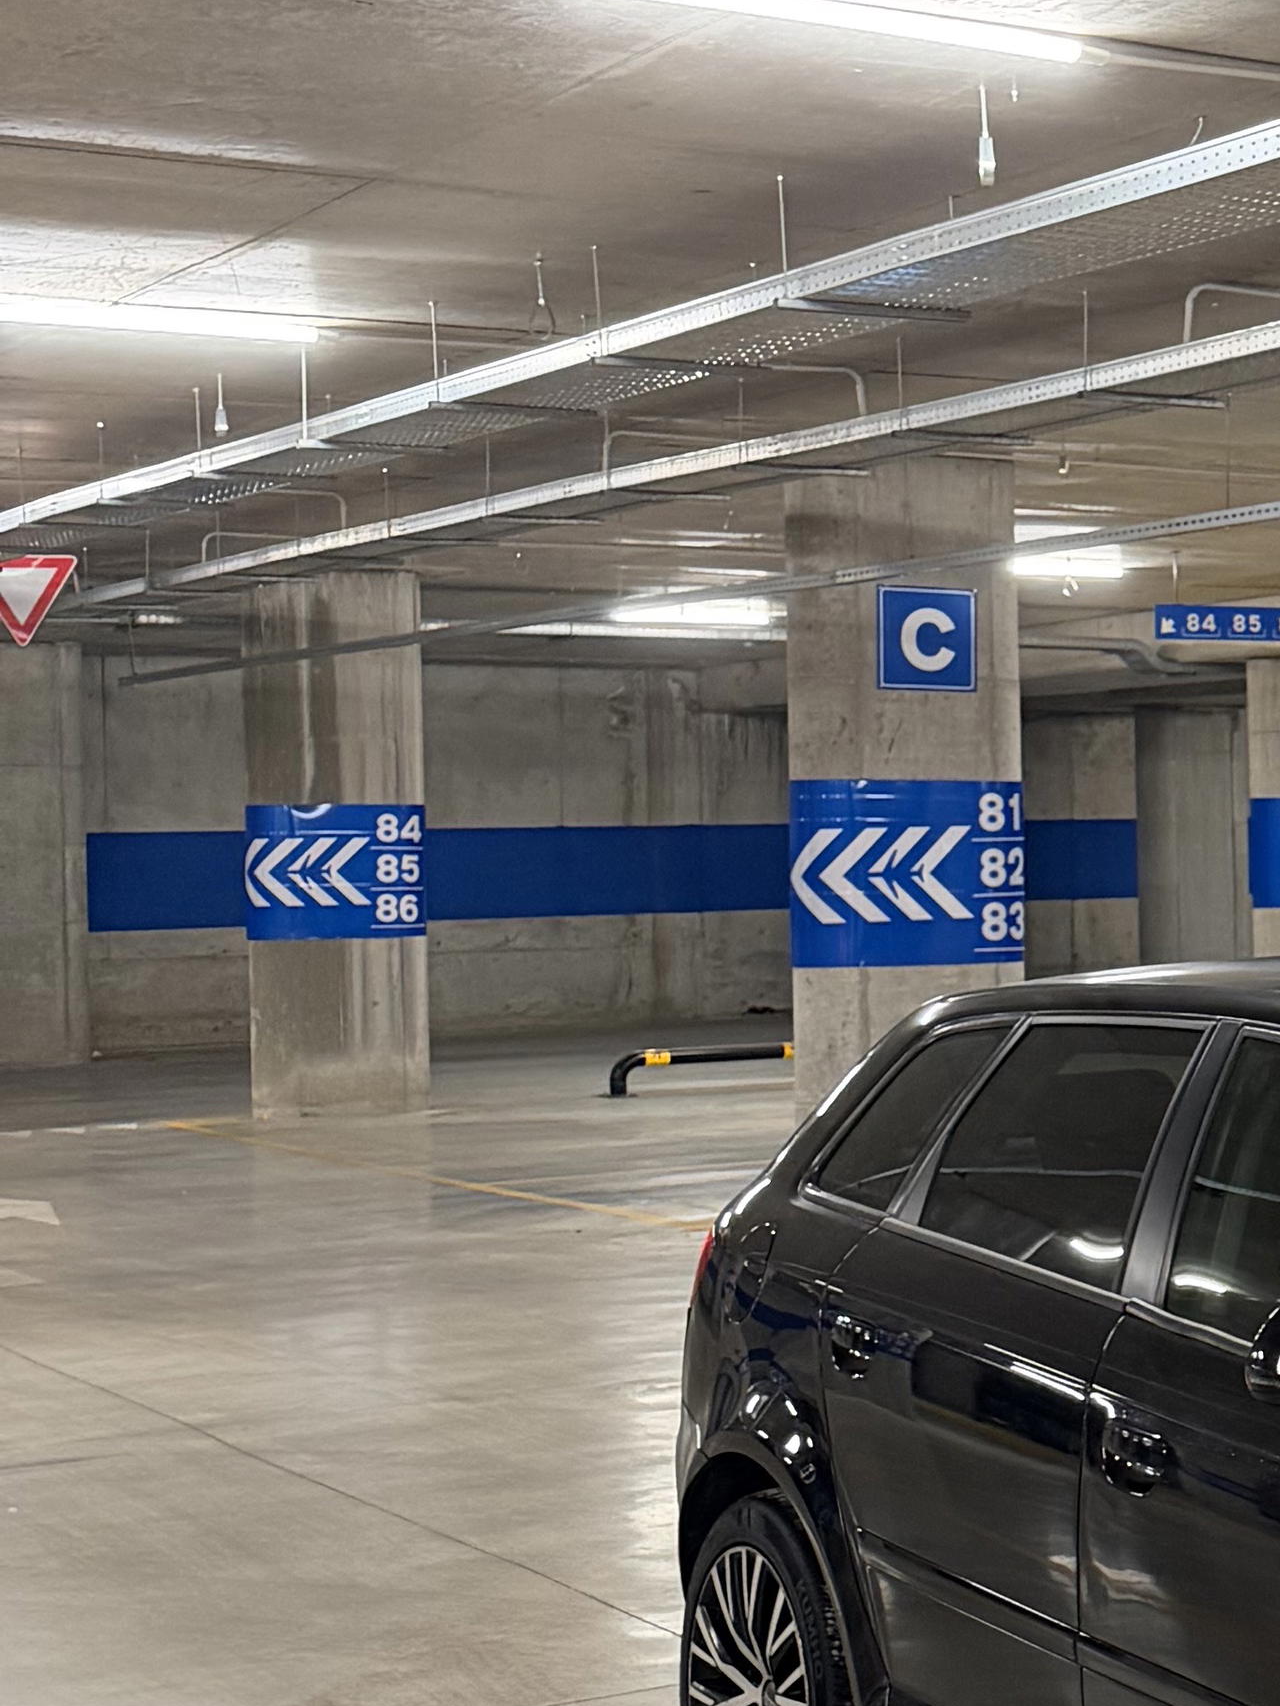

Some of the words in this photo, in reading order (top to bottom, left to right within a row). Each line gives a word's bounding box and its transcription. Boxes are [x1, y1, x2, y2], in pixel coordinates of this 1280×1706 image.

[901, 607, 956, 672] C
[1186, 612, 1217, 632] 84
[1232, 613, 1262, 633] 85
[375, 813, 422, 843] 84
[978, 792, 1021, 832] 81
[375, 853, 420, 883] 85
[979, 846, 1025, 888] 82
[375, 893, 419, 923] 86
[981, 900, 1025, 942] 83
